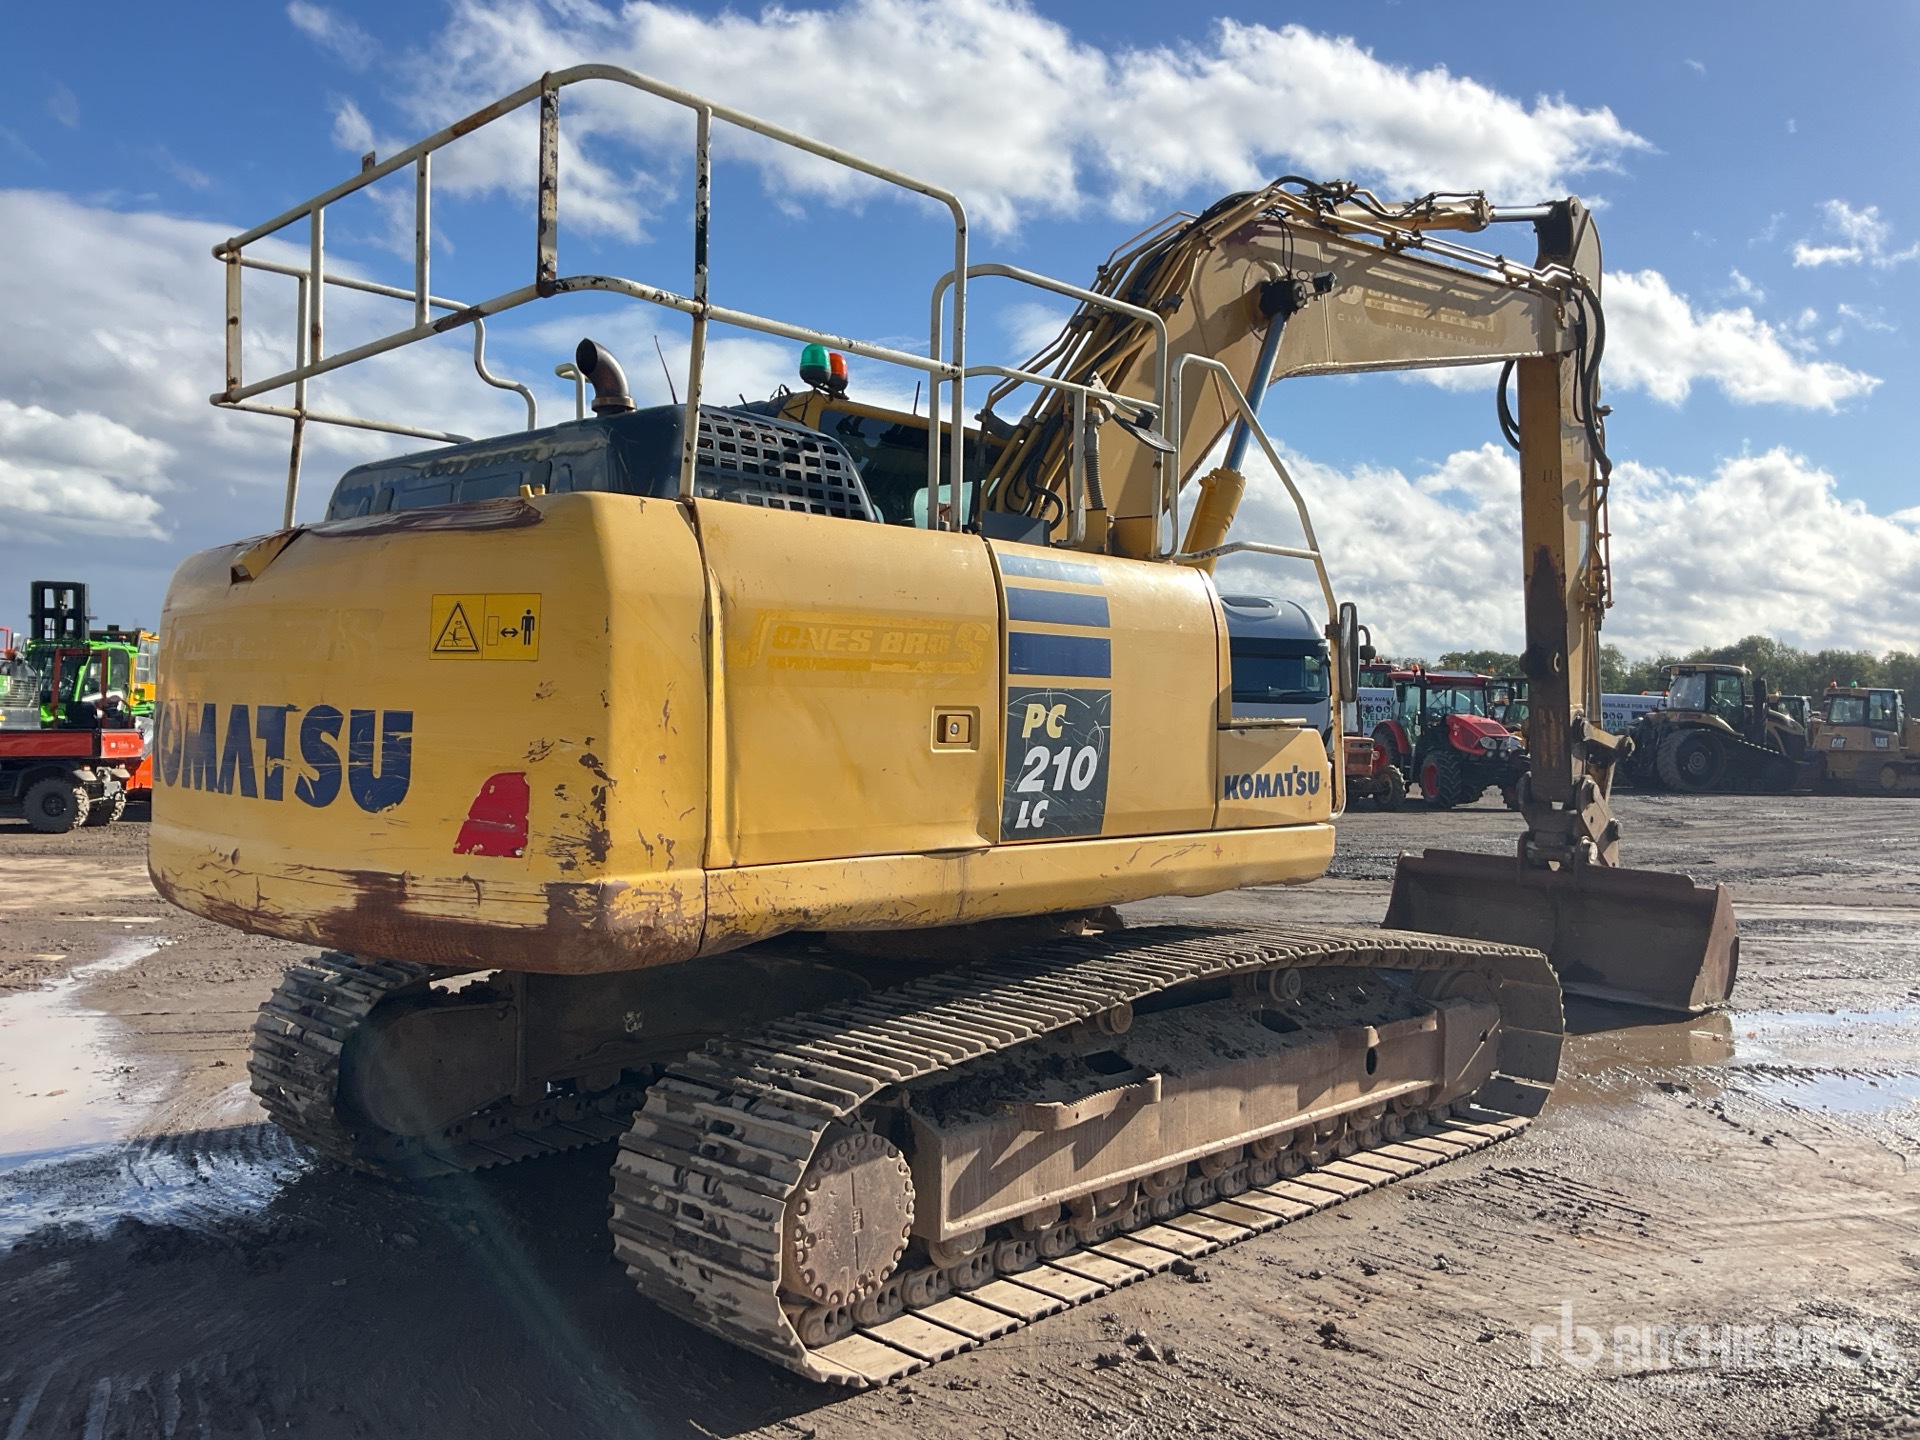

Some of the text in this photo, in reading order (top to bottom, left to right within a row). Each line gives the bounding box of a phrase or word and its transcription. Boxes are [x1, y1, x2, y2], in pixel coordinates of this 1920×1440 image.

[1022, 703, 1067, 739] PC
[1831, 738, 1846, 748] CAT
[1875, 737, 1888, 748] CAT
[1017, 745, 1098, 792] 210
[1224, 765, 1320, 800] KOMATSU
[1015, 799, 1049, 829] LC
